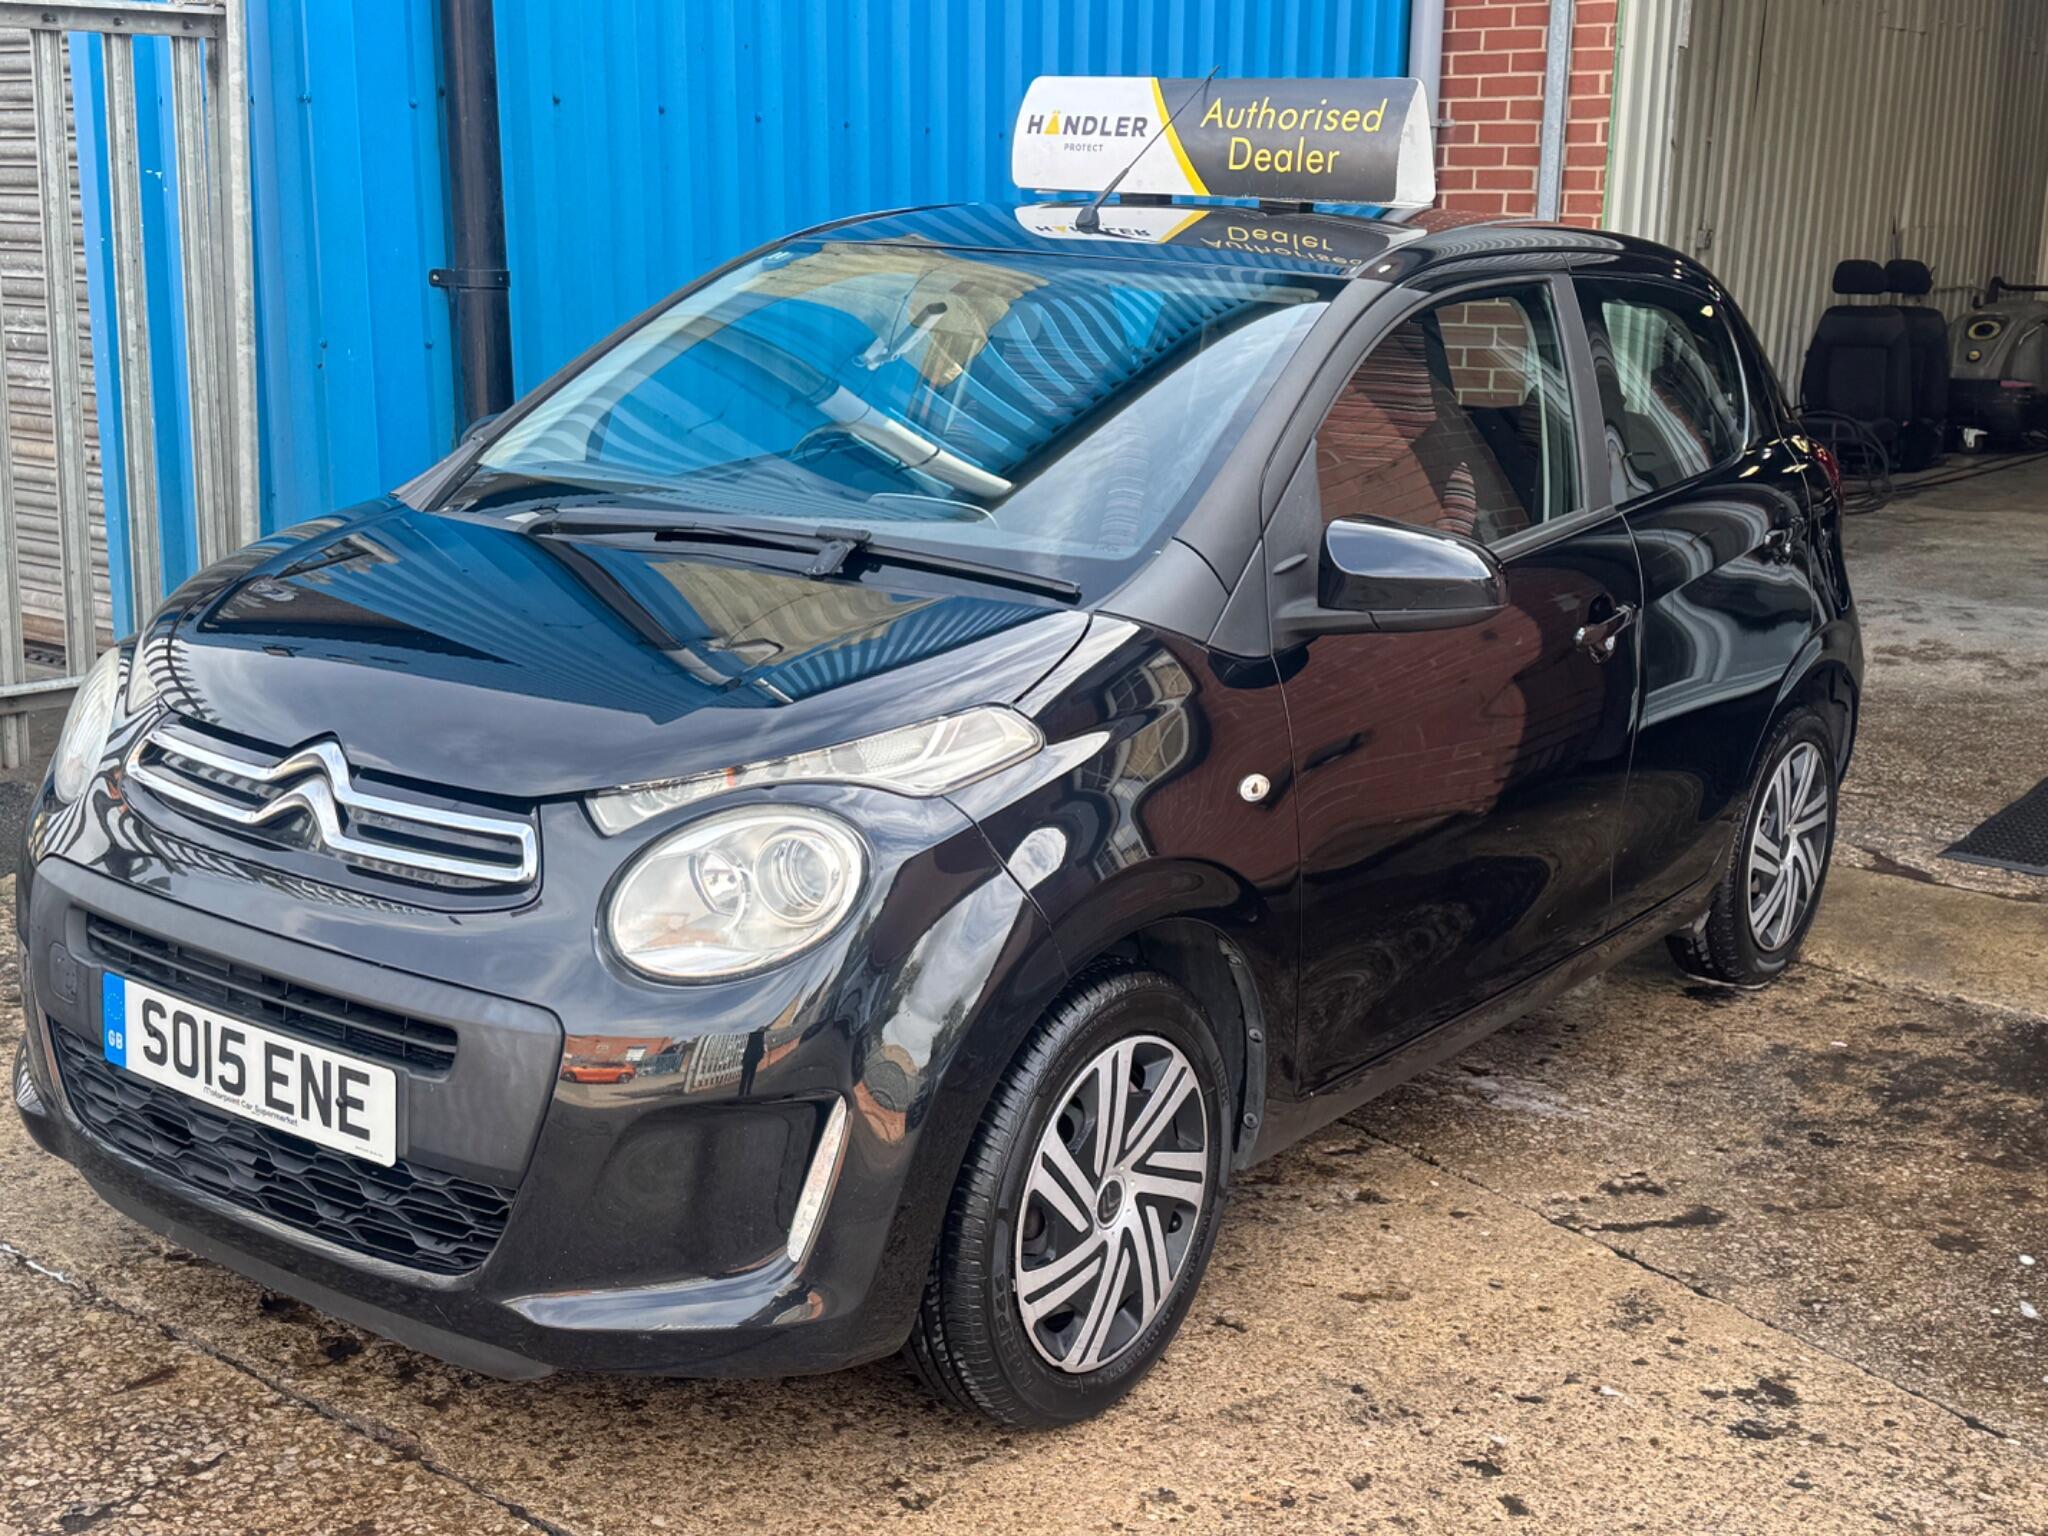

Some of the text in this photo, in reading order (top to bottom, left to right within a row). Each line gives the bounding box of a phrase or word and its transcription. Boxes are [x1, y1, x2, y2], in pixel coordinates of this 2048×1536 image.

[1200, 96, 1388, 132] Authorised
[1064, 143, 1104, 153] PROTECT
[1228, 136, 1341, 173] Dealer
[107, 1029, 123, 1050] GB
[142, 998, 370, 1141] SO15 ENE
[241, 1100, 253, 1110] Car
